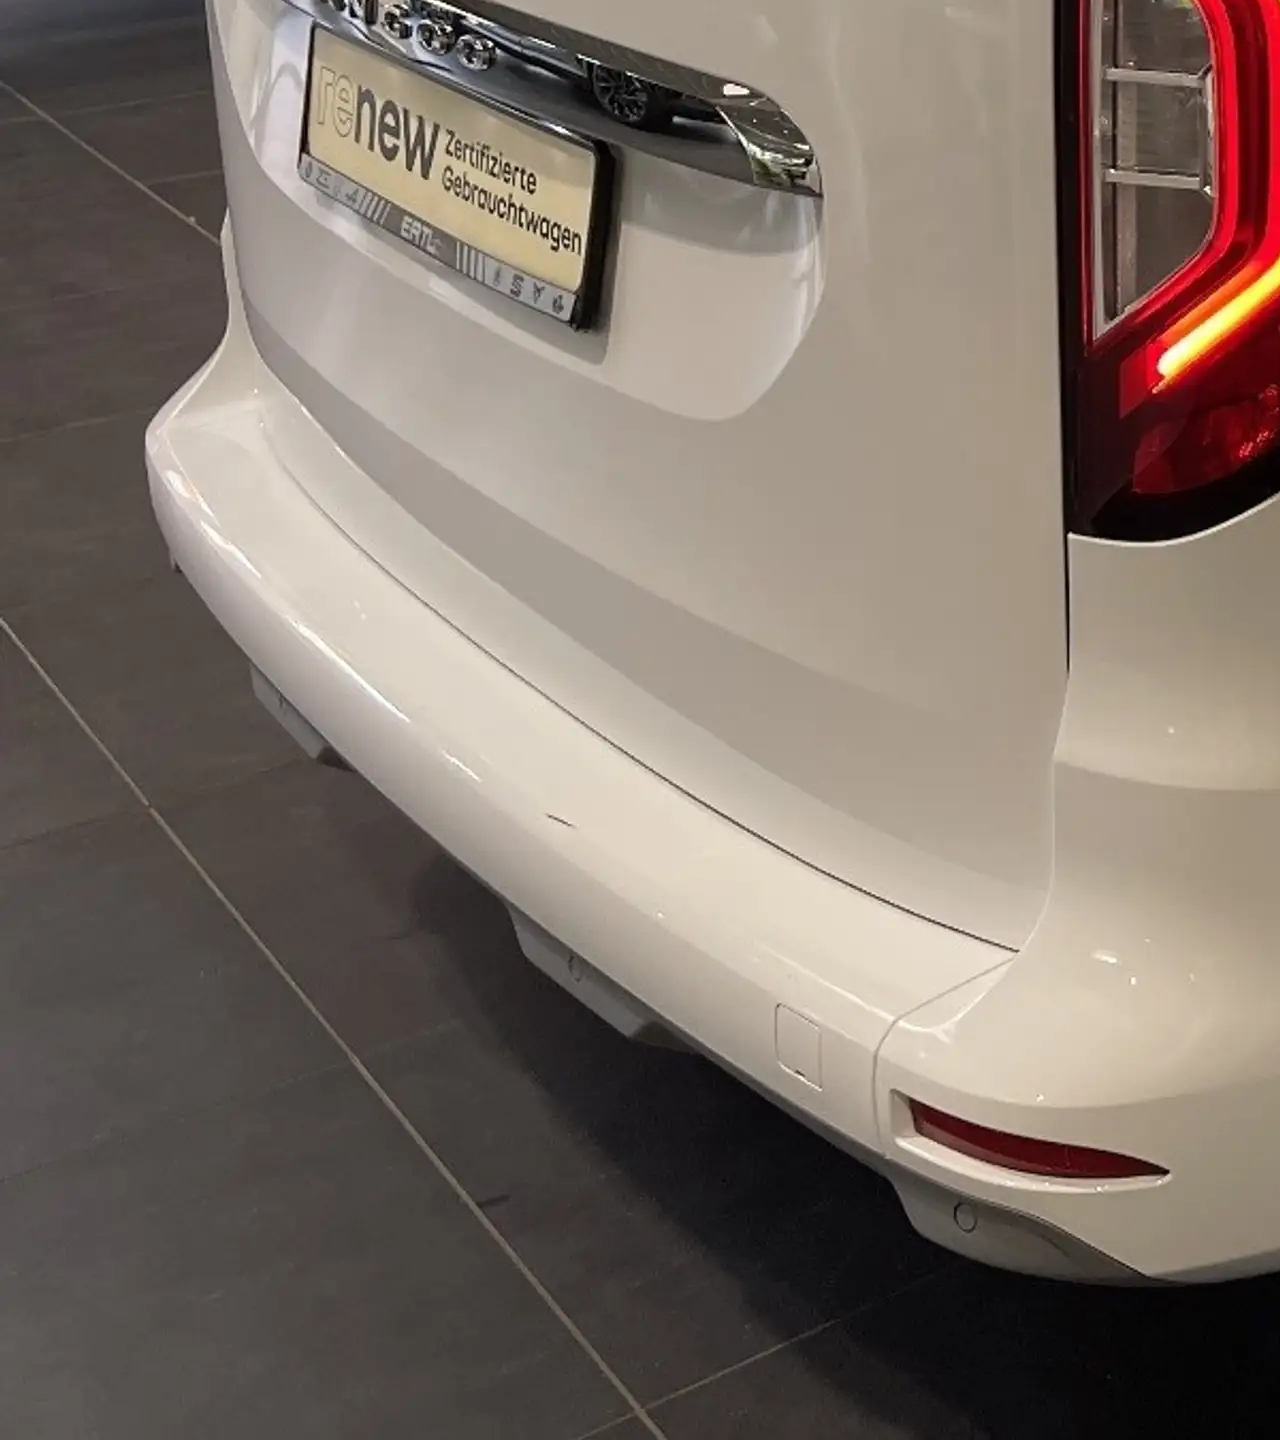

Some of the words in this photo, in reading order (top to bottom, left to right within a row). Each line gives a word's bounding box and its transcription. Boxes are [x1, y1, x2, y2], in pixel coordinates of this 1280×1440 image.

[317, 65, 441, 181] renew
[444, 128, 538, 196] Zertifizierte
[441, 165, 582, 256] Gebrauchtwagen
